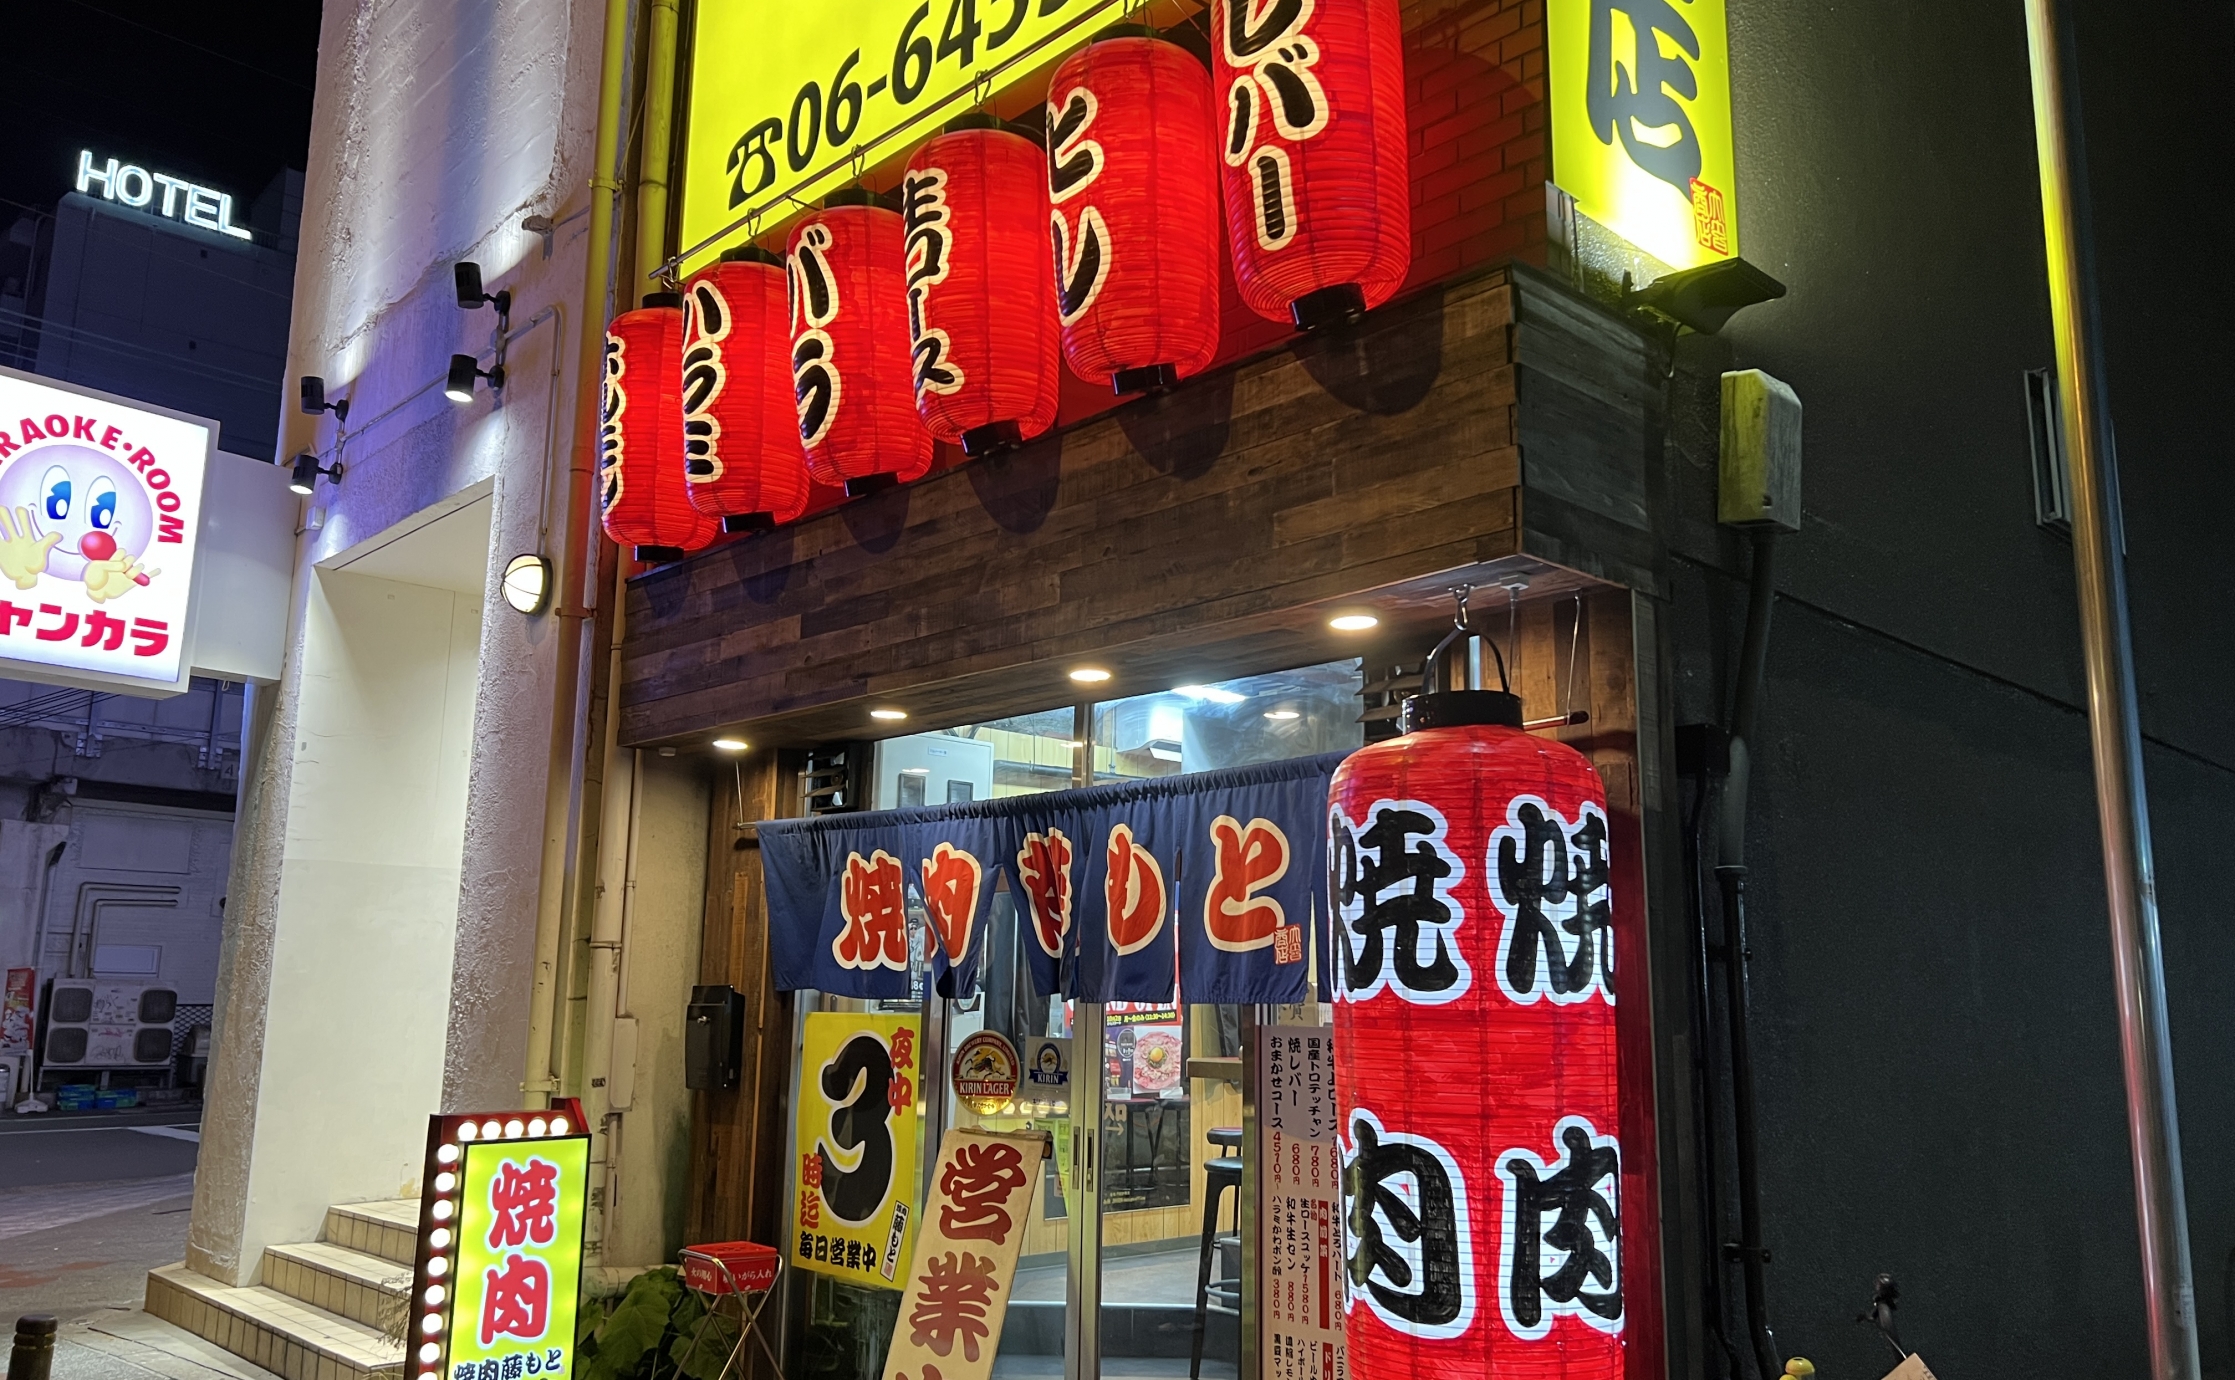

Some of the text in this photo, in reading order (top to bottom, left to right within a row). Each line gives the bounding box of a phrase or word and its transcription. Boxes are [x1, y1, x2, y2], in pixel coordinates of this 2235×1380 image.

[787, 0, 1069, 172] 06-64
[77, 150, 252, 240] HOTEL
[0, 414, 123, 464] RAOKE
[888, 1026, 914, 1116] 夜中
[959, 1082, 1010, 1095] KIRIN LAGER
[1037, 1073, 1059, 1084] KIRIN
[1270, 1036, 1283, 1129] おまかせコース
[1328, 799, 1475, 1338] 焼肉
[817, 1031, 895, 1225] 3
[1104, 1103, 1127, 1122] 入口
[1307, 1037, 1322, 1187] 国産トロテッチャン 780円
[1291, 1143, 1300, 1185] 680円
[479, 1157, 559, 1346] 焼肉
[799, 1231, 877, 1272] 毎日営業中
[893, 1143, 1027, 1380] 営業
[1273, 1279, 1281, 1319] 380円
[1287, 1281, 1295, 1322] 880円
[1335, 1346, 1345, 1380] バニラ
